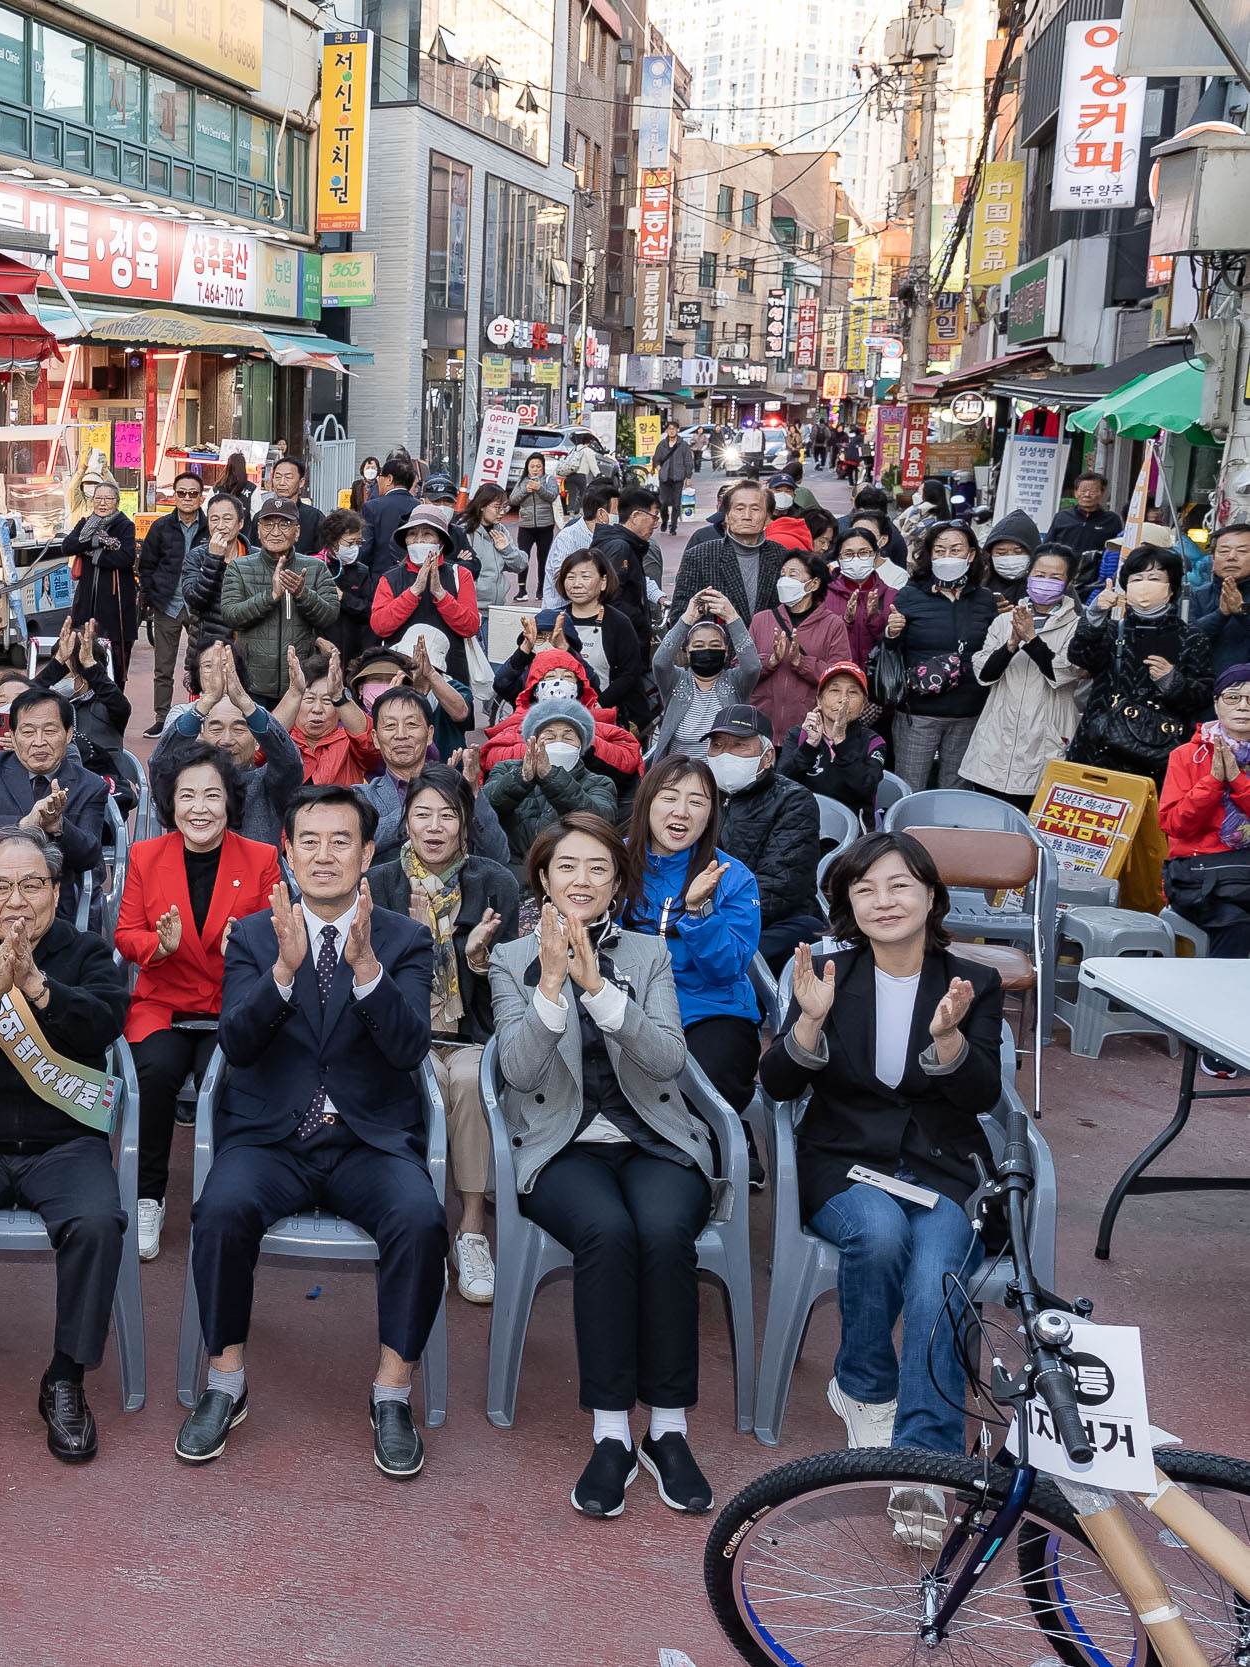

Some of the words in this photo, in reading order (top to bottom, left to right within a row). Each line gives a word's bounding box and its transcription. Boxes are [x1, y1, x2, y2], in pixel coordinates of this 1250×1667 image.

[5, 49, 21, 65] Clinic
[1069, 185, 1095, 198] 맥주
[1098, 184, 1124, 197] 양주
[980, 179, 1013, 271] 中国食品
[192, 233, 249, 281] 상주축산
[328, 261, 363, 278] 365
[328, 279, 346, 289] Auto
[347, 279, 367, 289] Bank
[494, 323, 509, 338] 약
[954, 399, 983, 414] 커피
[489, 413, 514, 425] OPEN
[1018, 445, 1056, 459] 삼성생명
[1040, 803, 1120, 846] 주차금지
[722, 1520, 754, 1559] COMPASS
